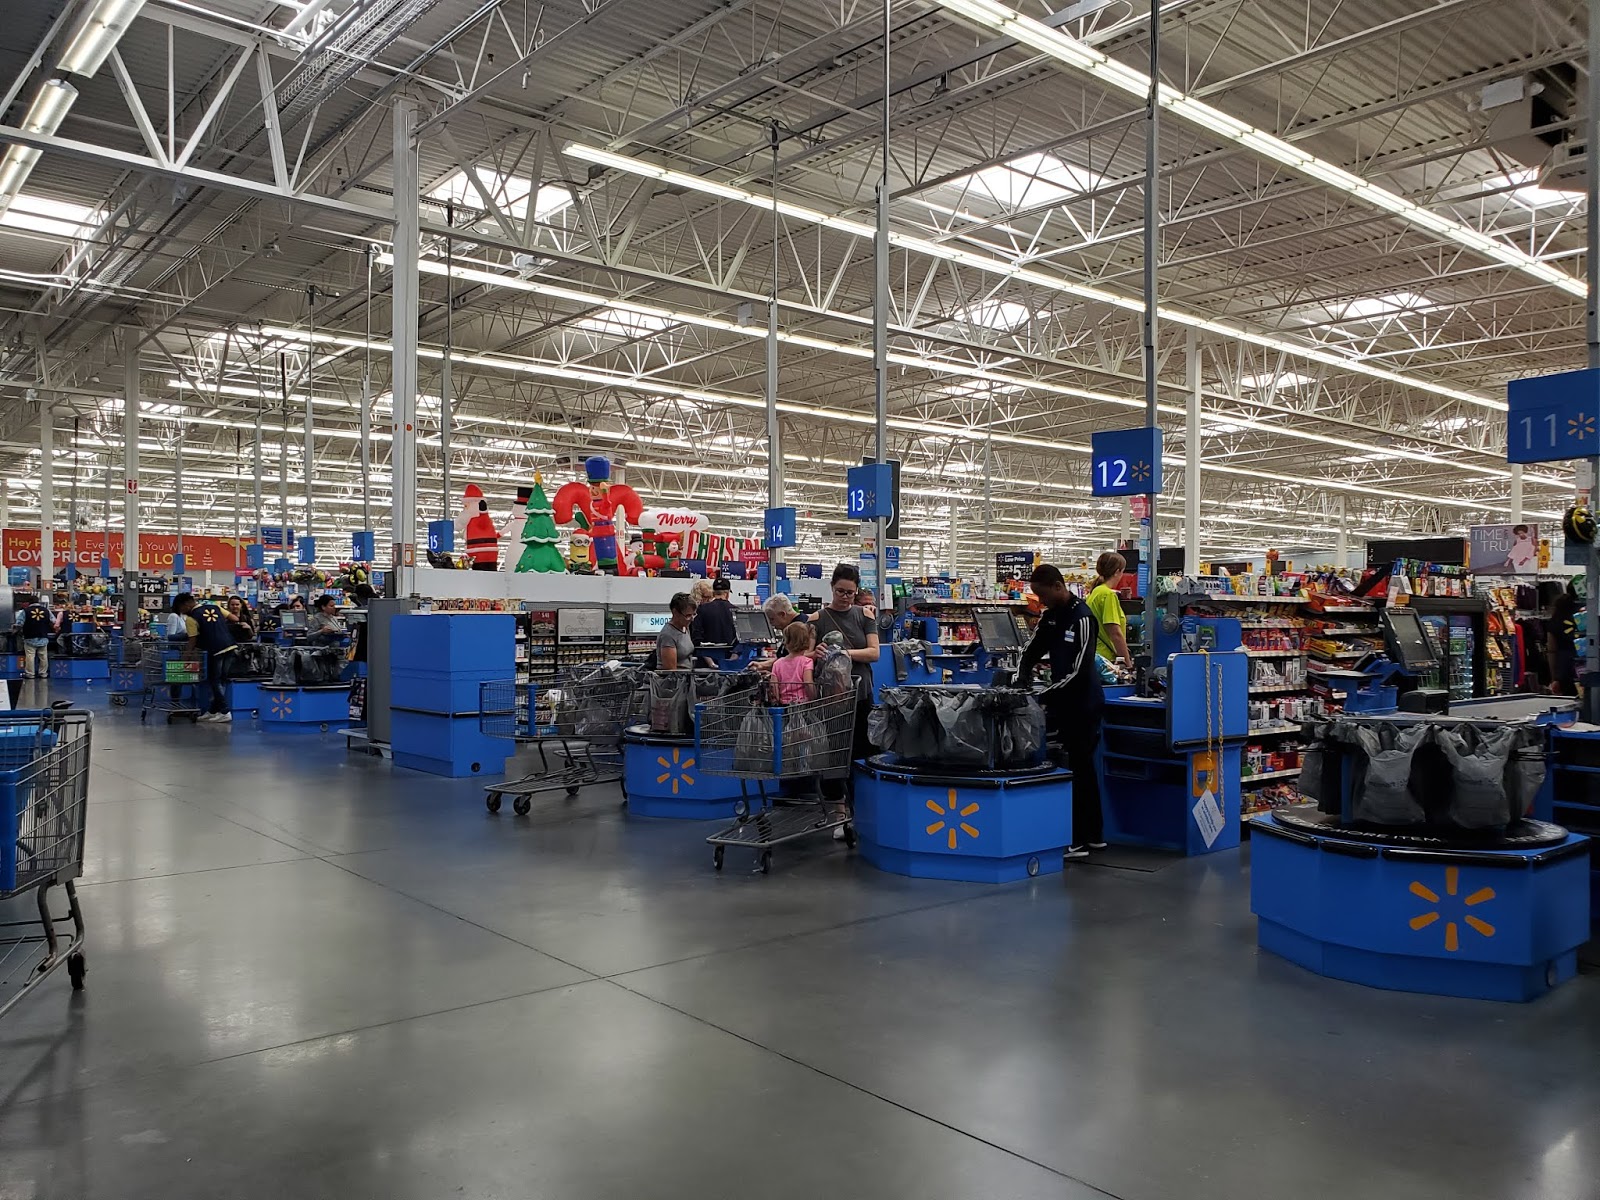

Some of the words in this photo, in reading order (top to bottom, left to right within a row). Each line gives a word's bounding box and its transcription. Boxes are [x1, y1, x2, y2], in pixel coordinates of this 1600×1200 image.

[1520, 413, 1557, 450] 11
[1098, 459, 1128, 488] 12
[850, 489, 865, 512] 13
[656, 512, 698, 528] Merry
[772, 525, 783, 542] 14
[1472, 529, 1503, 541] TIME
[8, 538, 31, 549] Hey
[35, 538, 78, 549] Frida!
[146, 541, 165, 552] You
[168, 542, 196, 552] Wnt.
[430, 535, 438, 549] 15
[116, 553, 150, 565] YU
[155, 553, 197, 566] LOE.
[353, 546, 360, 558] 16
